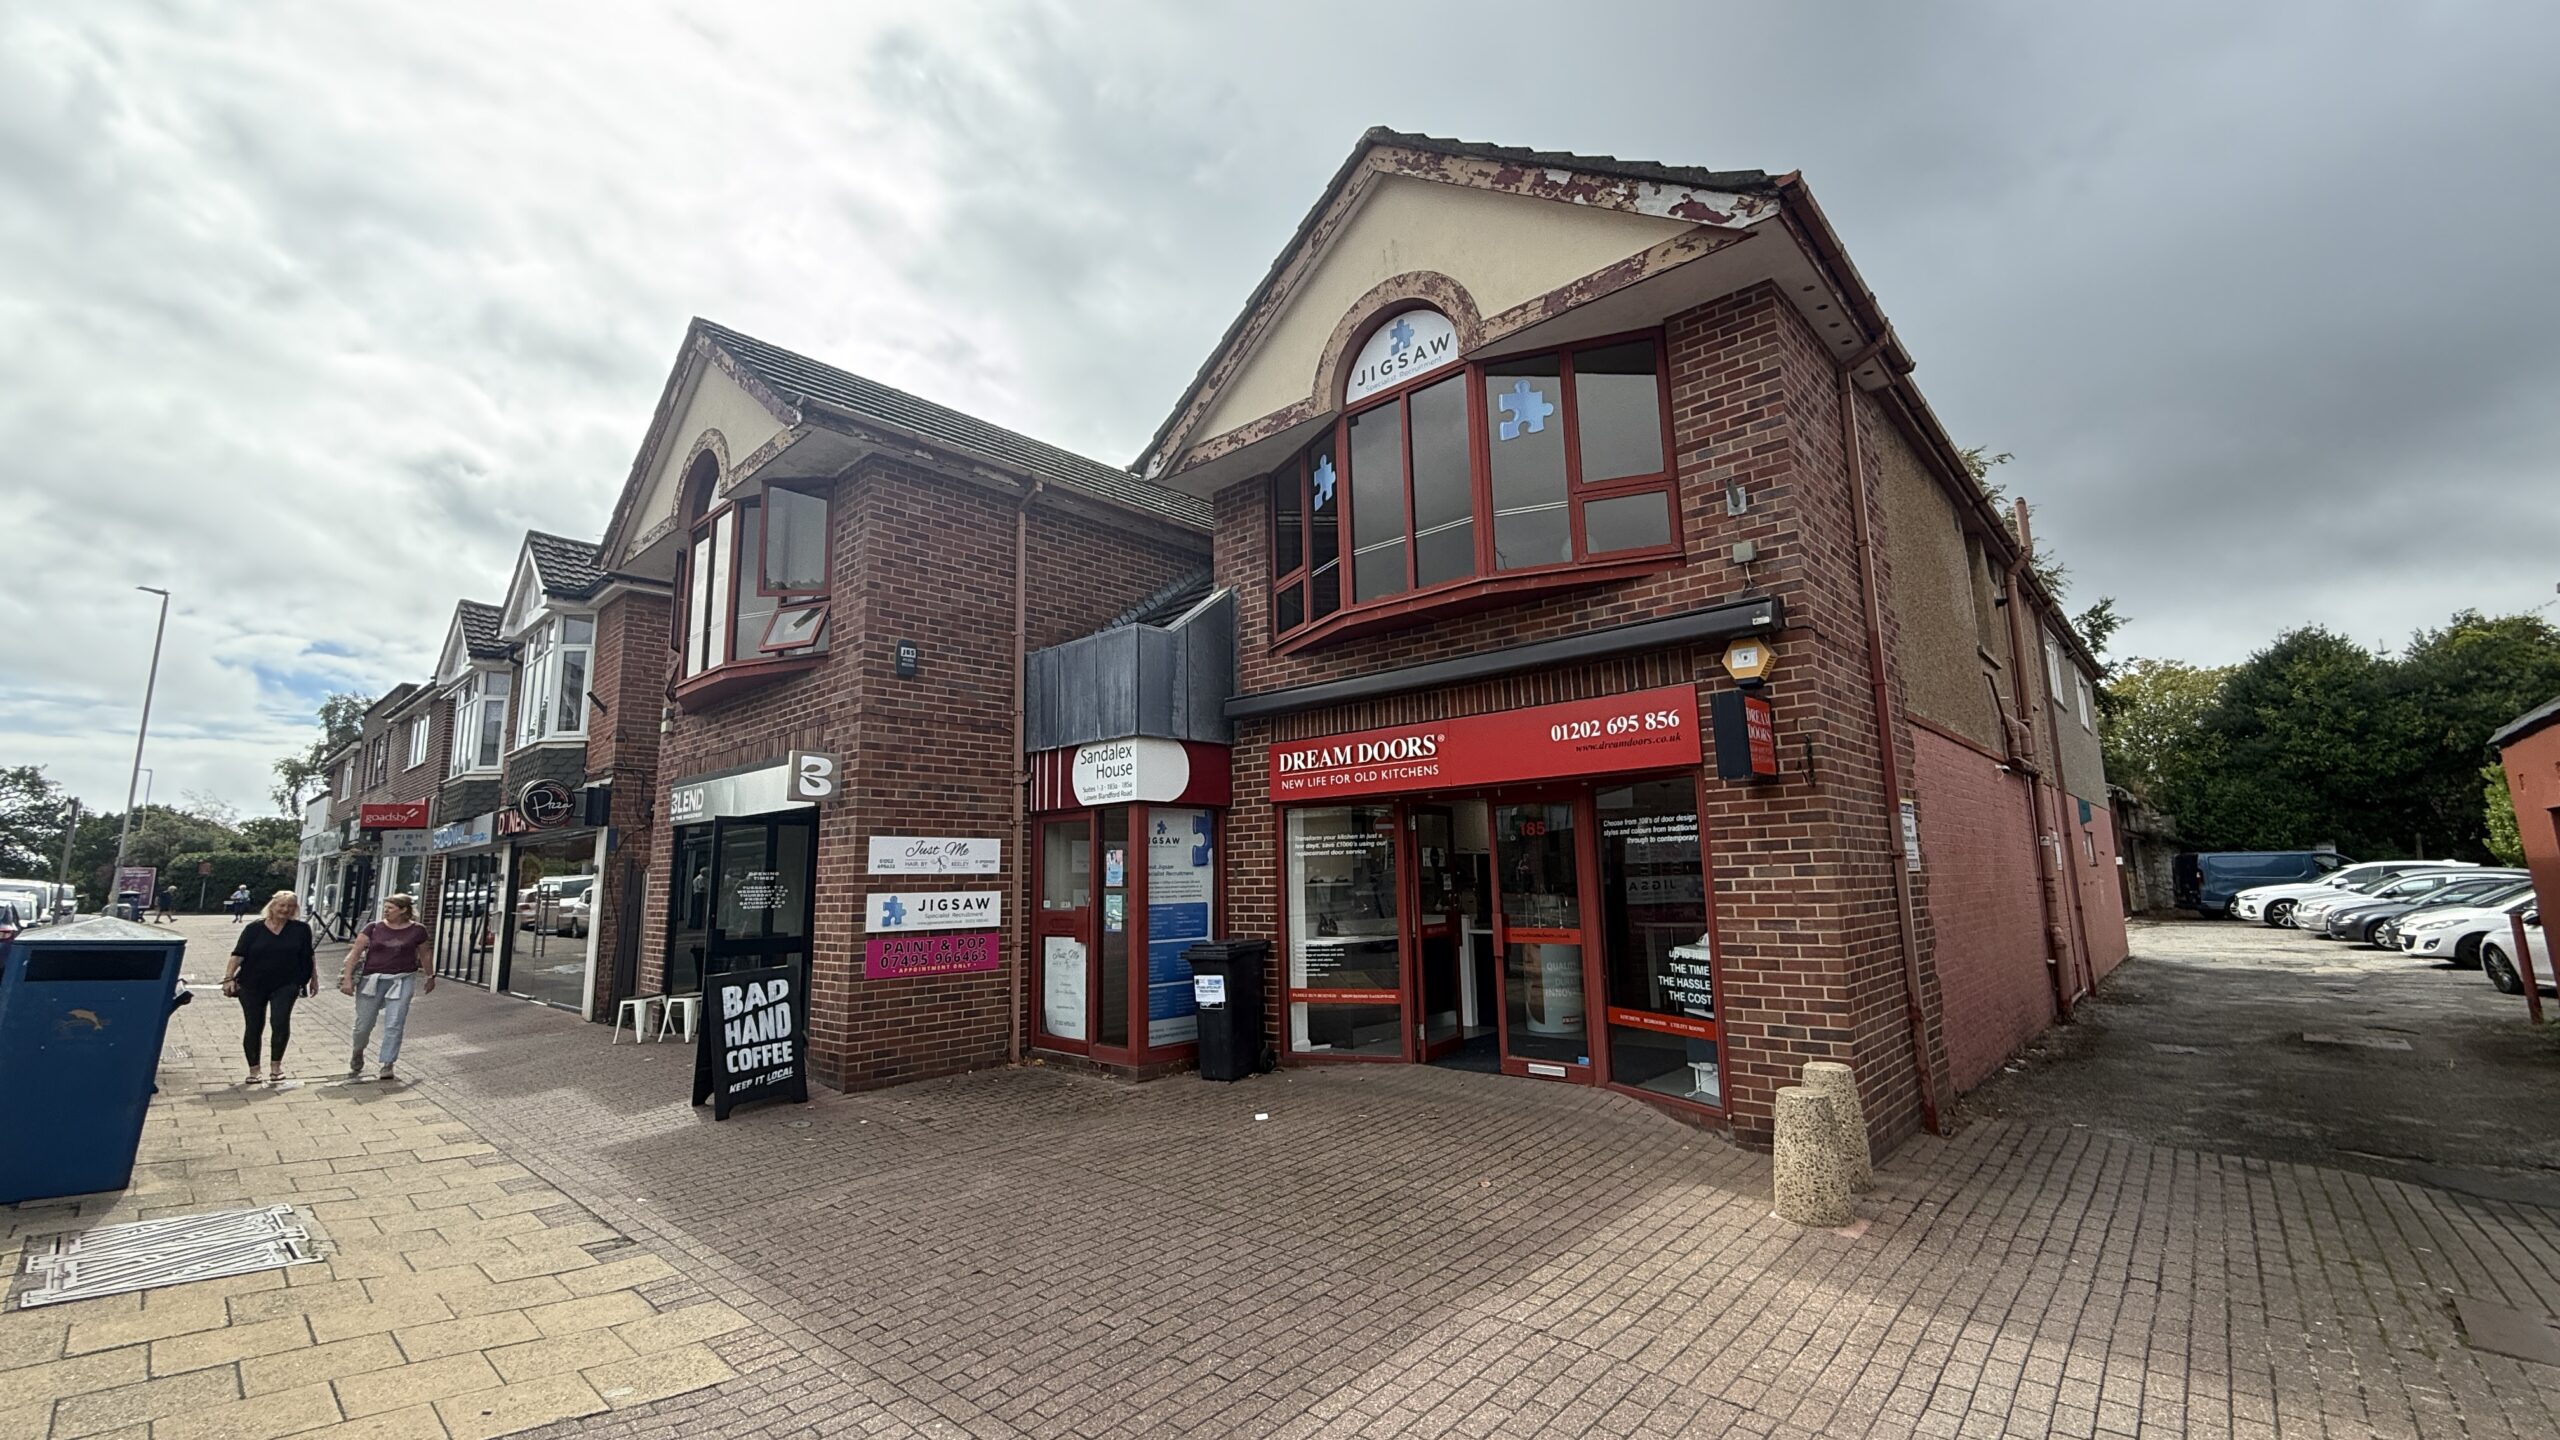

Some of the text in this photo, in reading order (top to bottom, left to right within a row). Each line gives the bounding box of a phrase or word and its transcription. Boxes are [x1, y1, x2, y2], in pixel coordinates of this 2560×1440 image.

[1357, 332, 1450, 387] JIGSAW
[1365, 355, 1442, 392] Specialist Recruitment
[1551, 709, 1680, 742] 01202 695 856
[1745, 707, 1771, 726] DREAM
[1747, 723, 1772, 741] DOORS
[1576, 732, 1681, 752] www.dreamdoors.co.uk
[1081, 743, 1132, 765] Sandalex
[1279, 745, 1352, 773] DREAM
[1096, 763, 1133, 780] House
[1281, 764, 1439, 790] NEW LIFE FOR OLD KITCHENS
[671, 787, 705, 815] BLEND
[365, 809, 409, 824] goadsby
[1676, 814, 1697, 823] design
[1520, 821, 1545, 836] 185
[1603, 829, 1618, 837] styles
[1667, 824, 1697, 832] traditional
[1148, 836, 1180, 845] IGSAW
[1657, 835, 1698, 843] contemporary
[905, 840, 970, 857] Just Me
[918, 897, 990, 911] JIGSAW
[884, 937, 986, 955] PAINT & POP
[1669, 950, 1679, 960] up
[880, 950, 987, 969] 07495 966463
[898, 964, 951, 974] APPOINTMENT
[1669, 963, 1710, 976] THE TIME
[1657, 975, 1711, 991] THE HASSLE
[722, 979, 789, 1020] BAD
[1668, 990, 1712, 1005] THE COST
[724, 1002, 792, 1048] HAND
[726, 1040, 794, 1074] COFFEE
[728, 1066, 794, 1094] KEEP IT LOCAL
